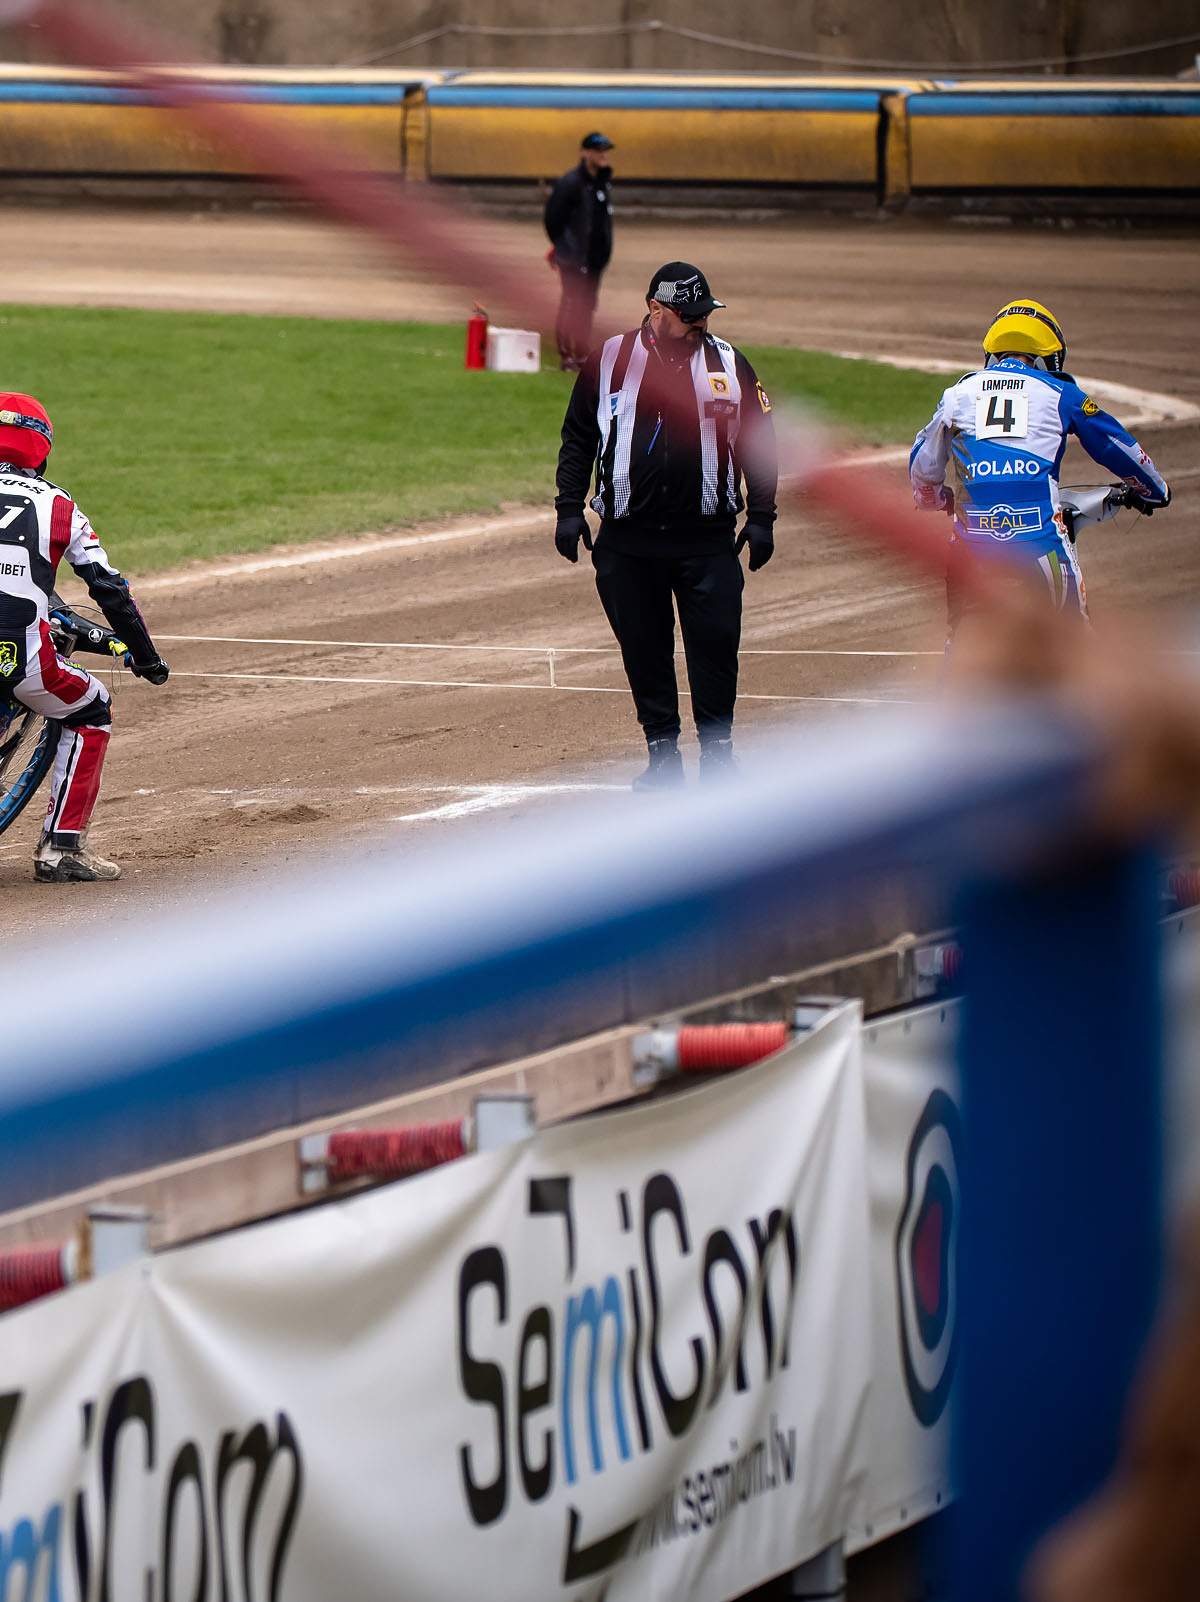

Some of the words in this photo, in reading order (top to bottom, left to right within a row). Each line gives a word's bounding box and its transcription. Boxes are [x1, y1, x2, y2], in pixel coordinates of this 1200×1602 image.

[982, 379, 1026, 391] LAMPART
[985, 395, 1016, 433] 4
[979, 515, 1028, 529] REALL
